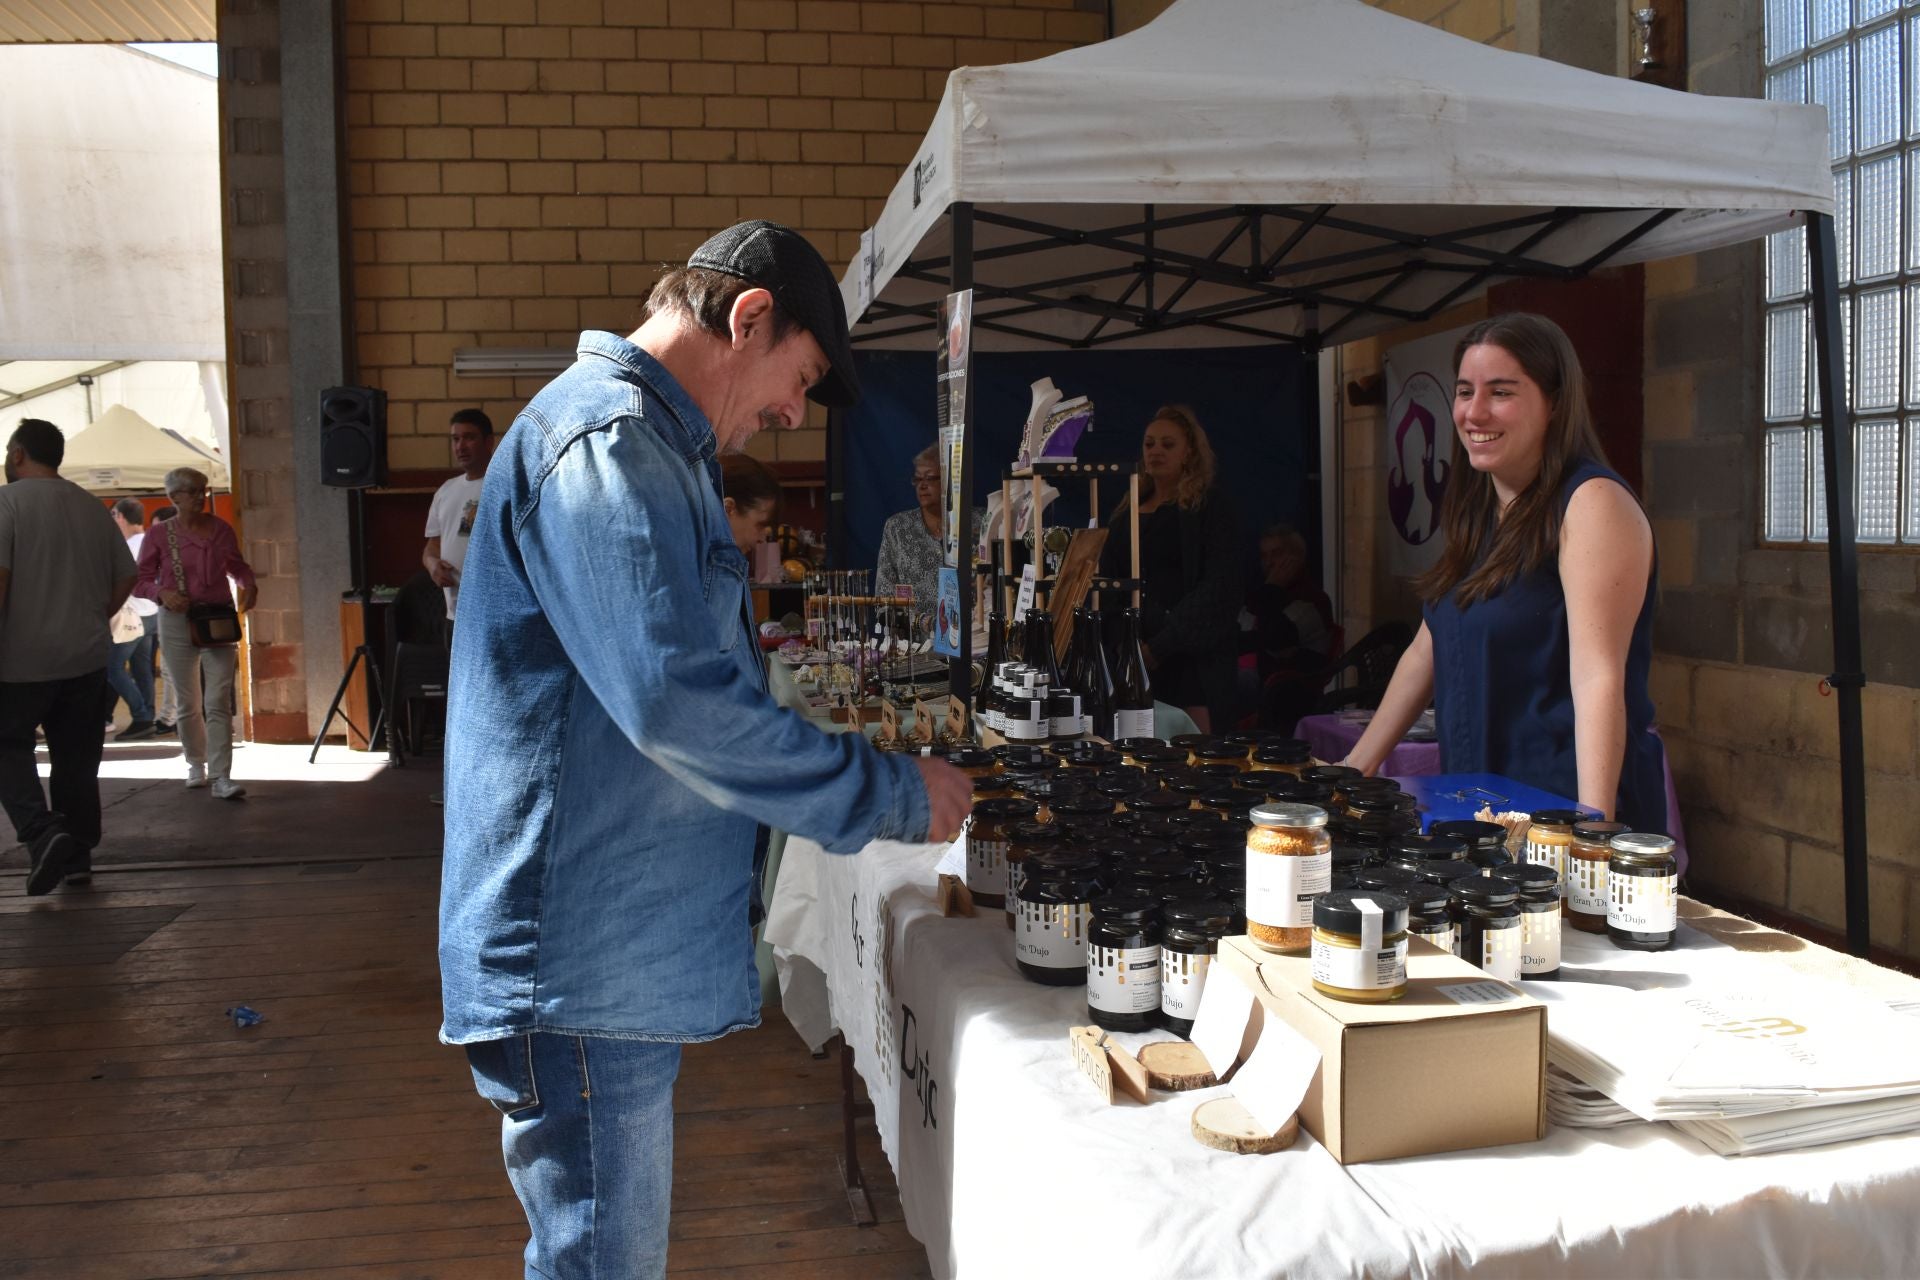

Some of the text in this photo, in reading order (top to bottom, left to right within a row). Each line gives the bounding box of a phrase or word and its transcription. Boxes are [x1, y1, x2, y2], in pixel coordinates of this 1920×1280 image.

[1573, 895, 1591, 907] Gran
[1622, 913, 1646, 926] Dujo
[1029, 944, 1049, 958] Dujo
[1521, 954, 1546, 967] Dujo
[1164, 994, 1183, 1010] Dujo
